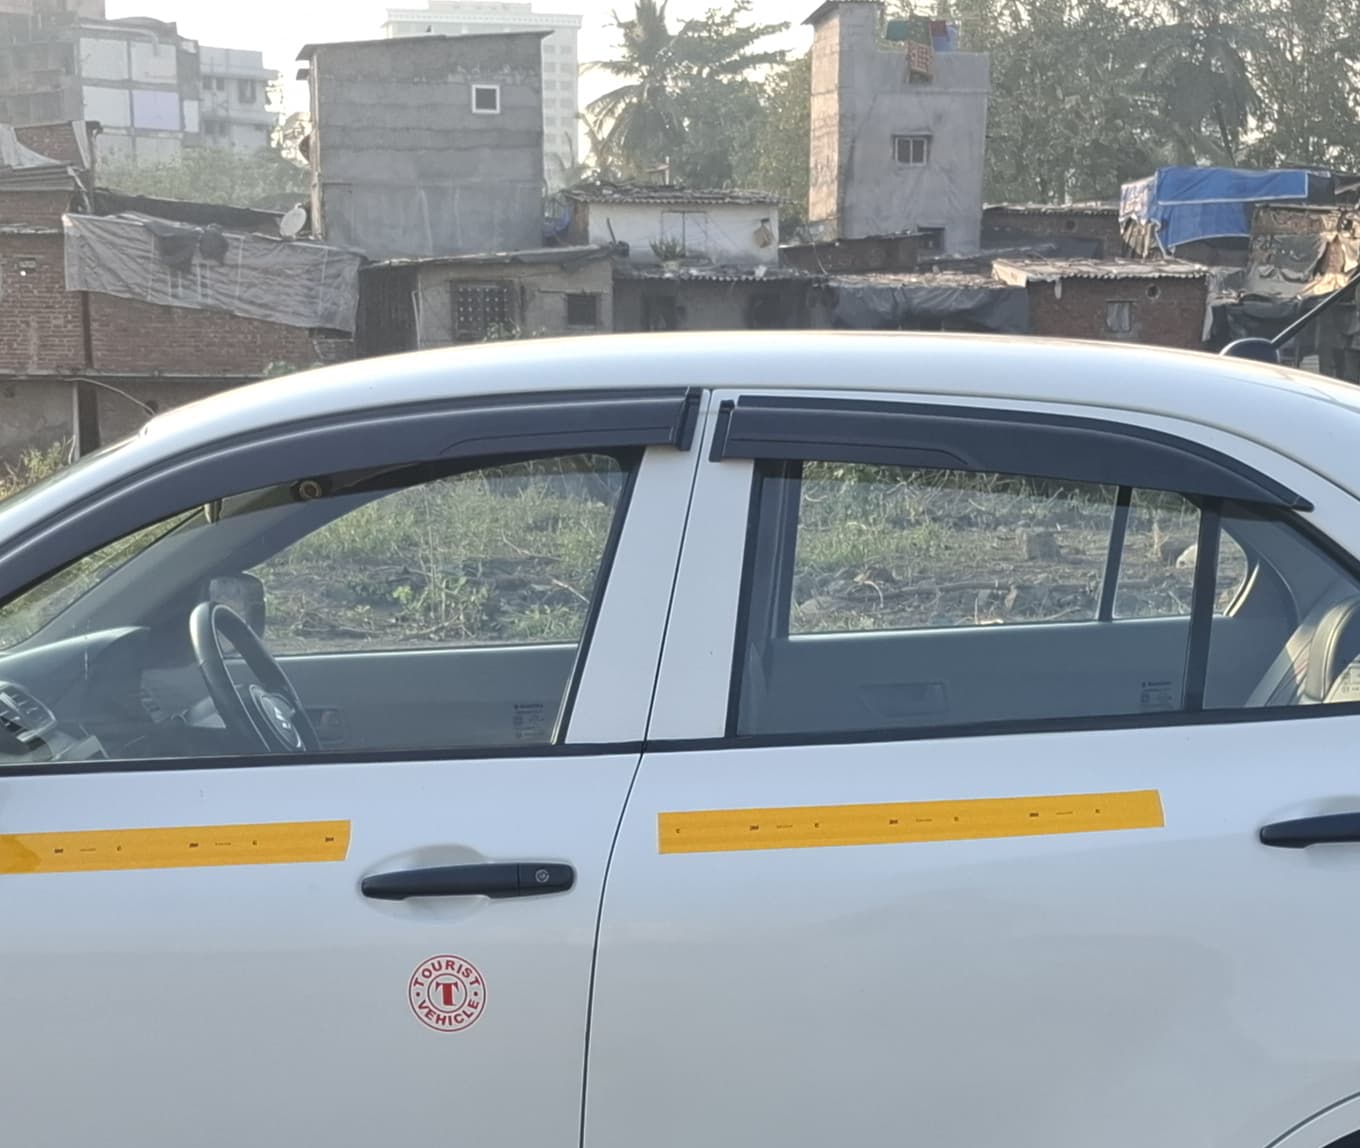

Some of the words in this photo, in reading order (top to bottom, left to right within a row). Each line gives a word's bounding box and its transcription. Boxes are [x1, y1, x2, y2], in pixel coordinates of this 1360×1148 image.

[412, 959, 481, 988] TOURIST
[434, 980, 460, 1007] T
[417, 998, 480, 1026] VEHICLE
